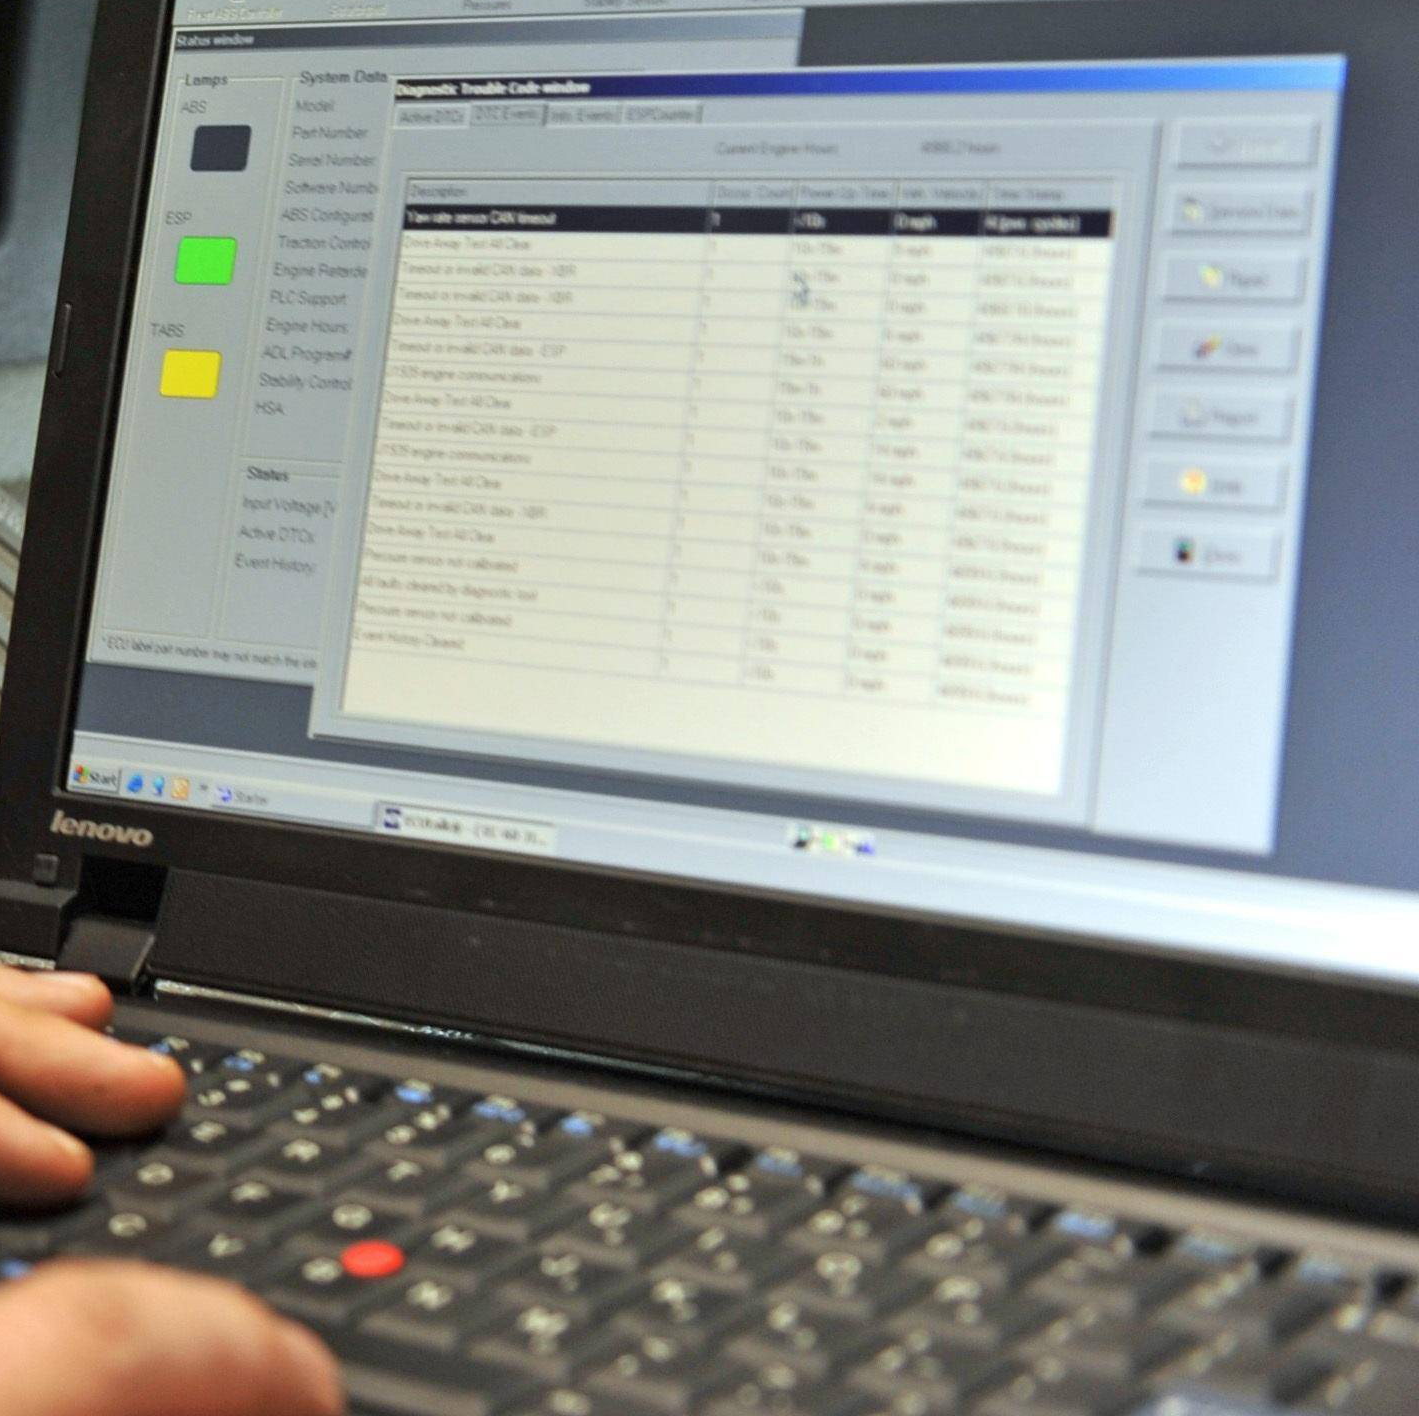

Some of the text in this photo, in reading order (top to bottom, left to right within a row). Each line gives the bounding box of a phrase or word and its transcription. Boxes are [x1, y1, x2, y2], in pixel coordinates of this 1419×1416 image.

[175, 32, 255, 48] Status window
[183, 72, 229, 89] Lamps
[298, 68, 389, 86] System Data
[394, 79, 592, 99] Diagnostic Trouble Code window
[180, 100, 208, 114] ABS
[164, 210, 192, 225] ESP
[148, 322, 186, 337] TABS
[246, 466, 290, 482] Status
[88, 767, 119, 787] Start
[50, 809, 154, 847] lenovo
